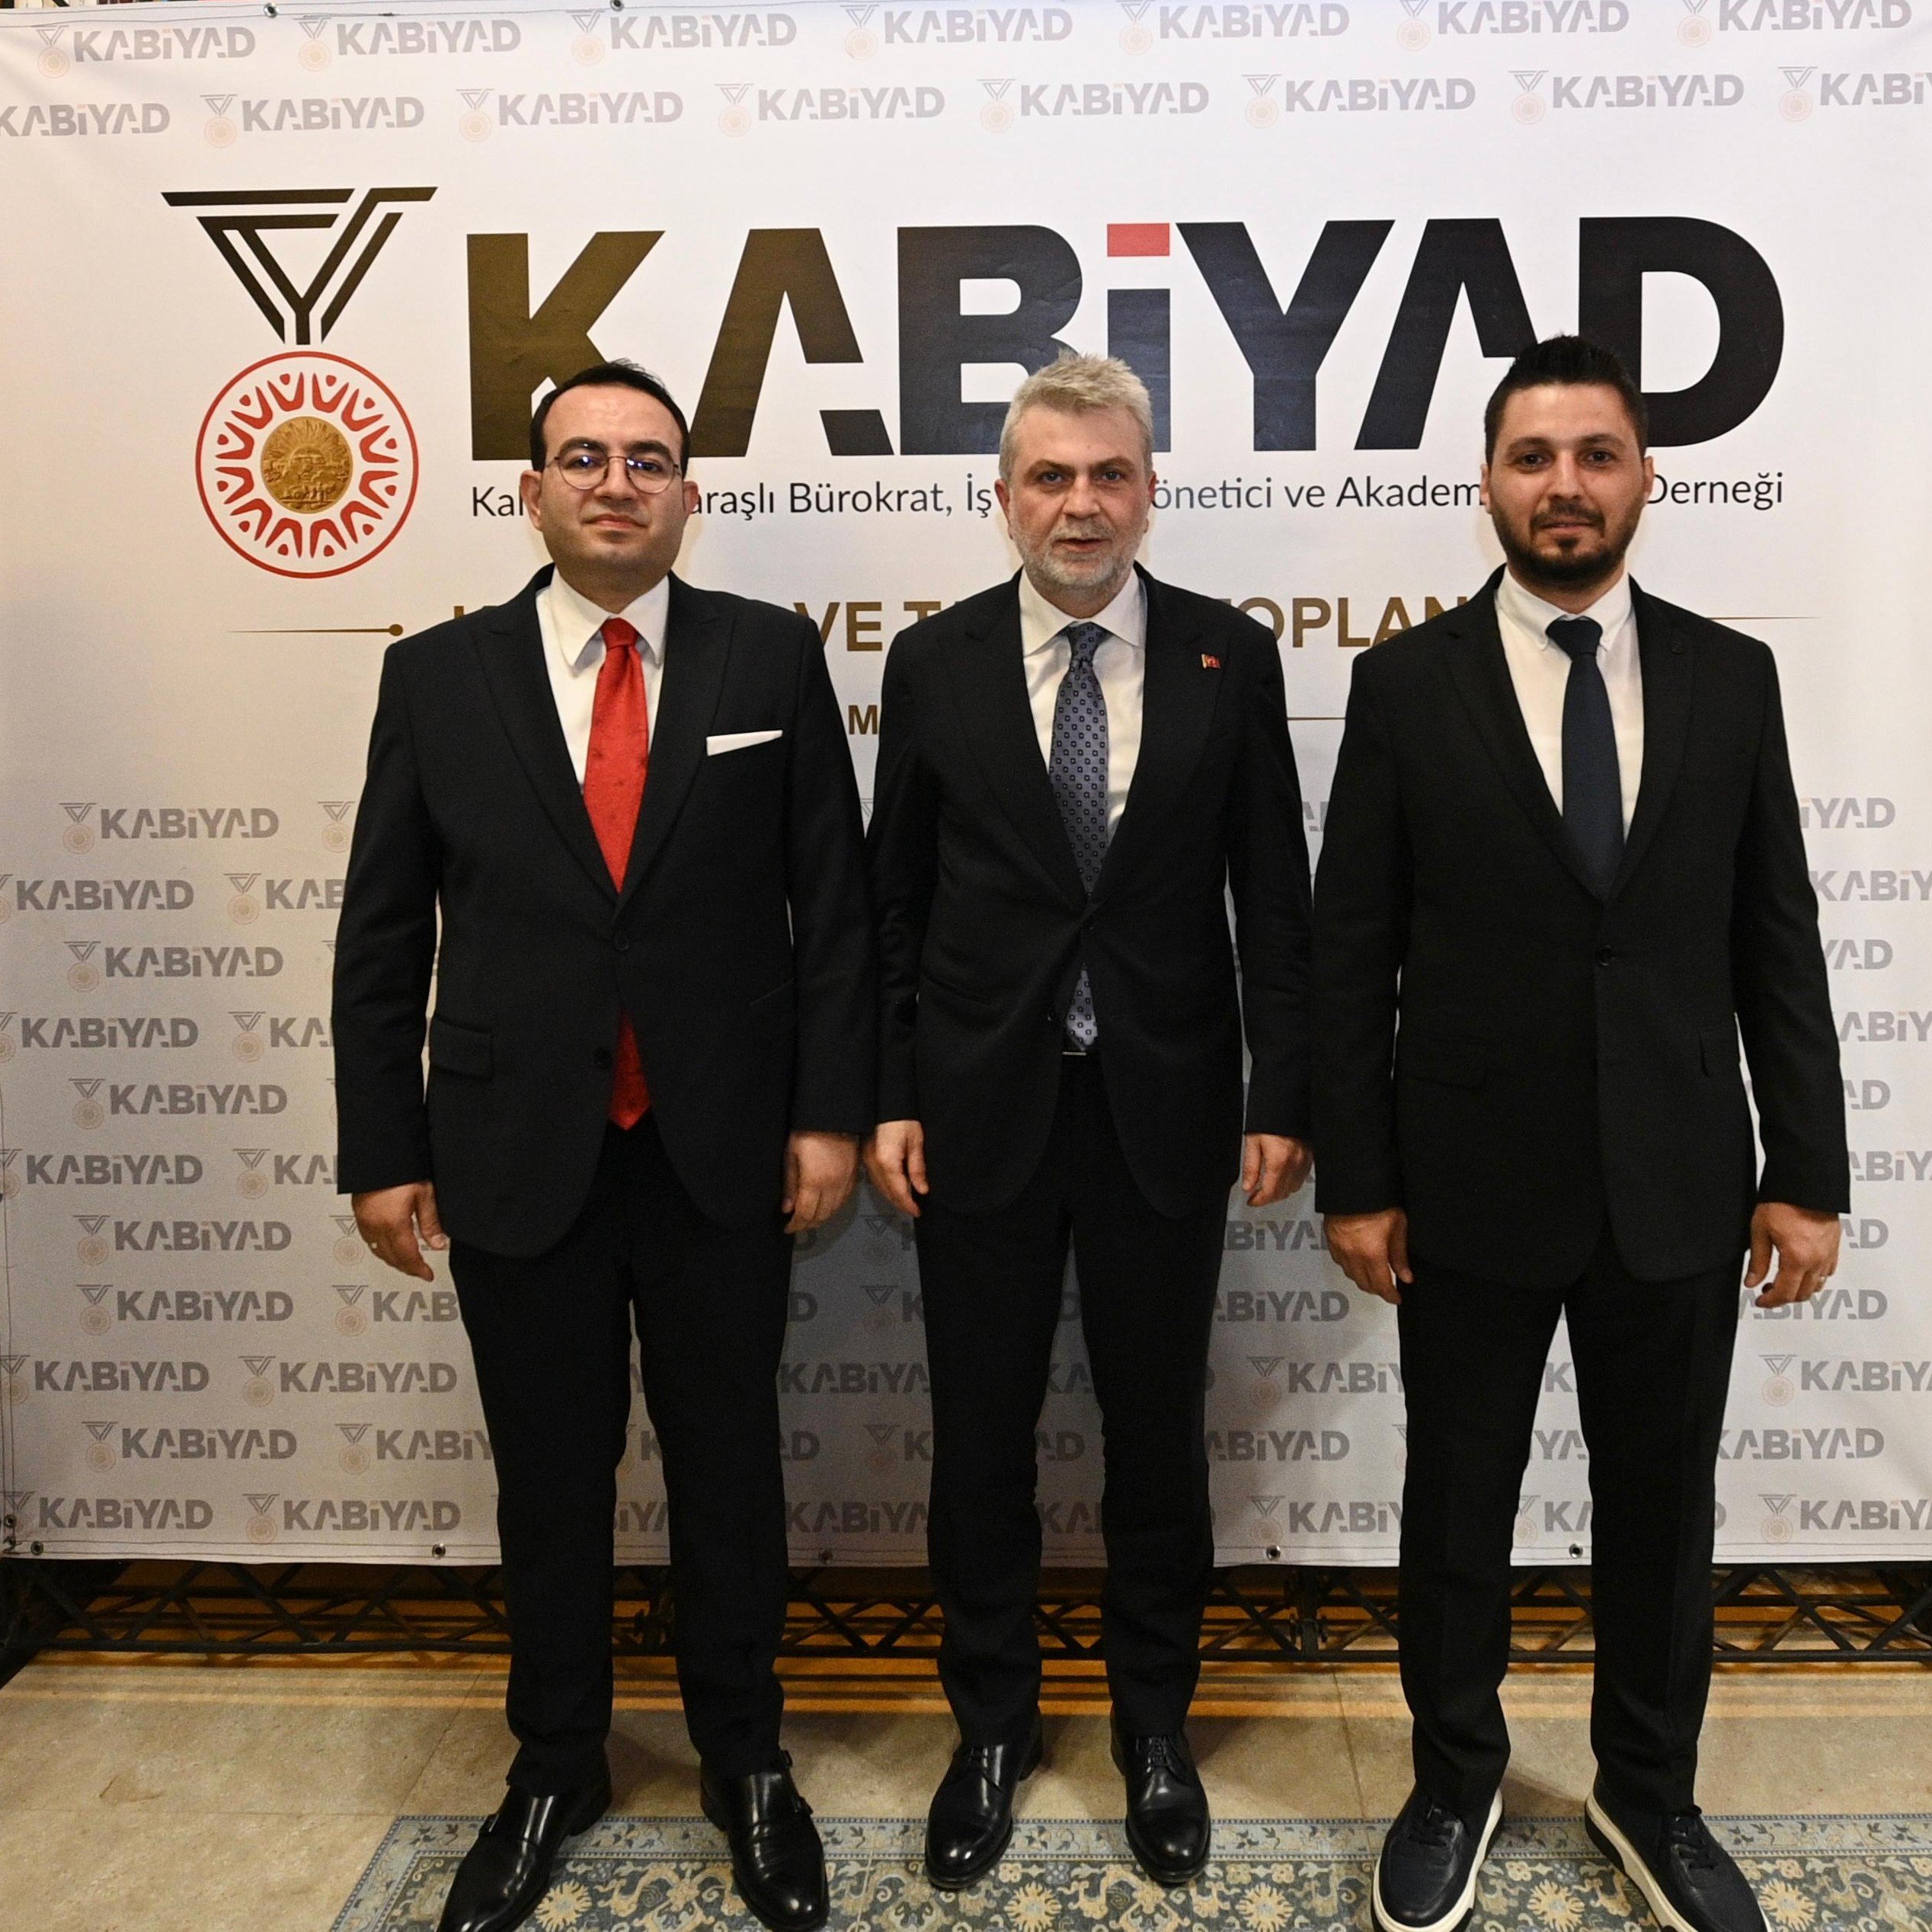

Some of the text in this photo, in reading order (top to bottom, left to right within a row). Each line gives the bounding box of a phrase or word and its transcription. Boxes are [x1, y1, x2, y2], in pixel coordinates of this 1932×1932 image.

[790, 481, 952, 517] Bürokrat,
[967, 473, 991, 518] İş
[1152, 477, 1272, 510] önetici
[1284, 484, 1326, 508] ve
[1647, 472, 1783, 510] Derneği
